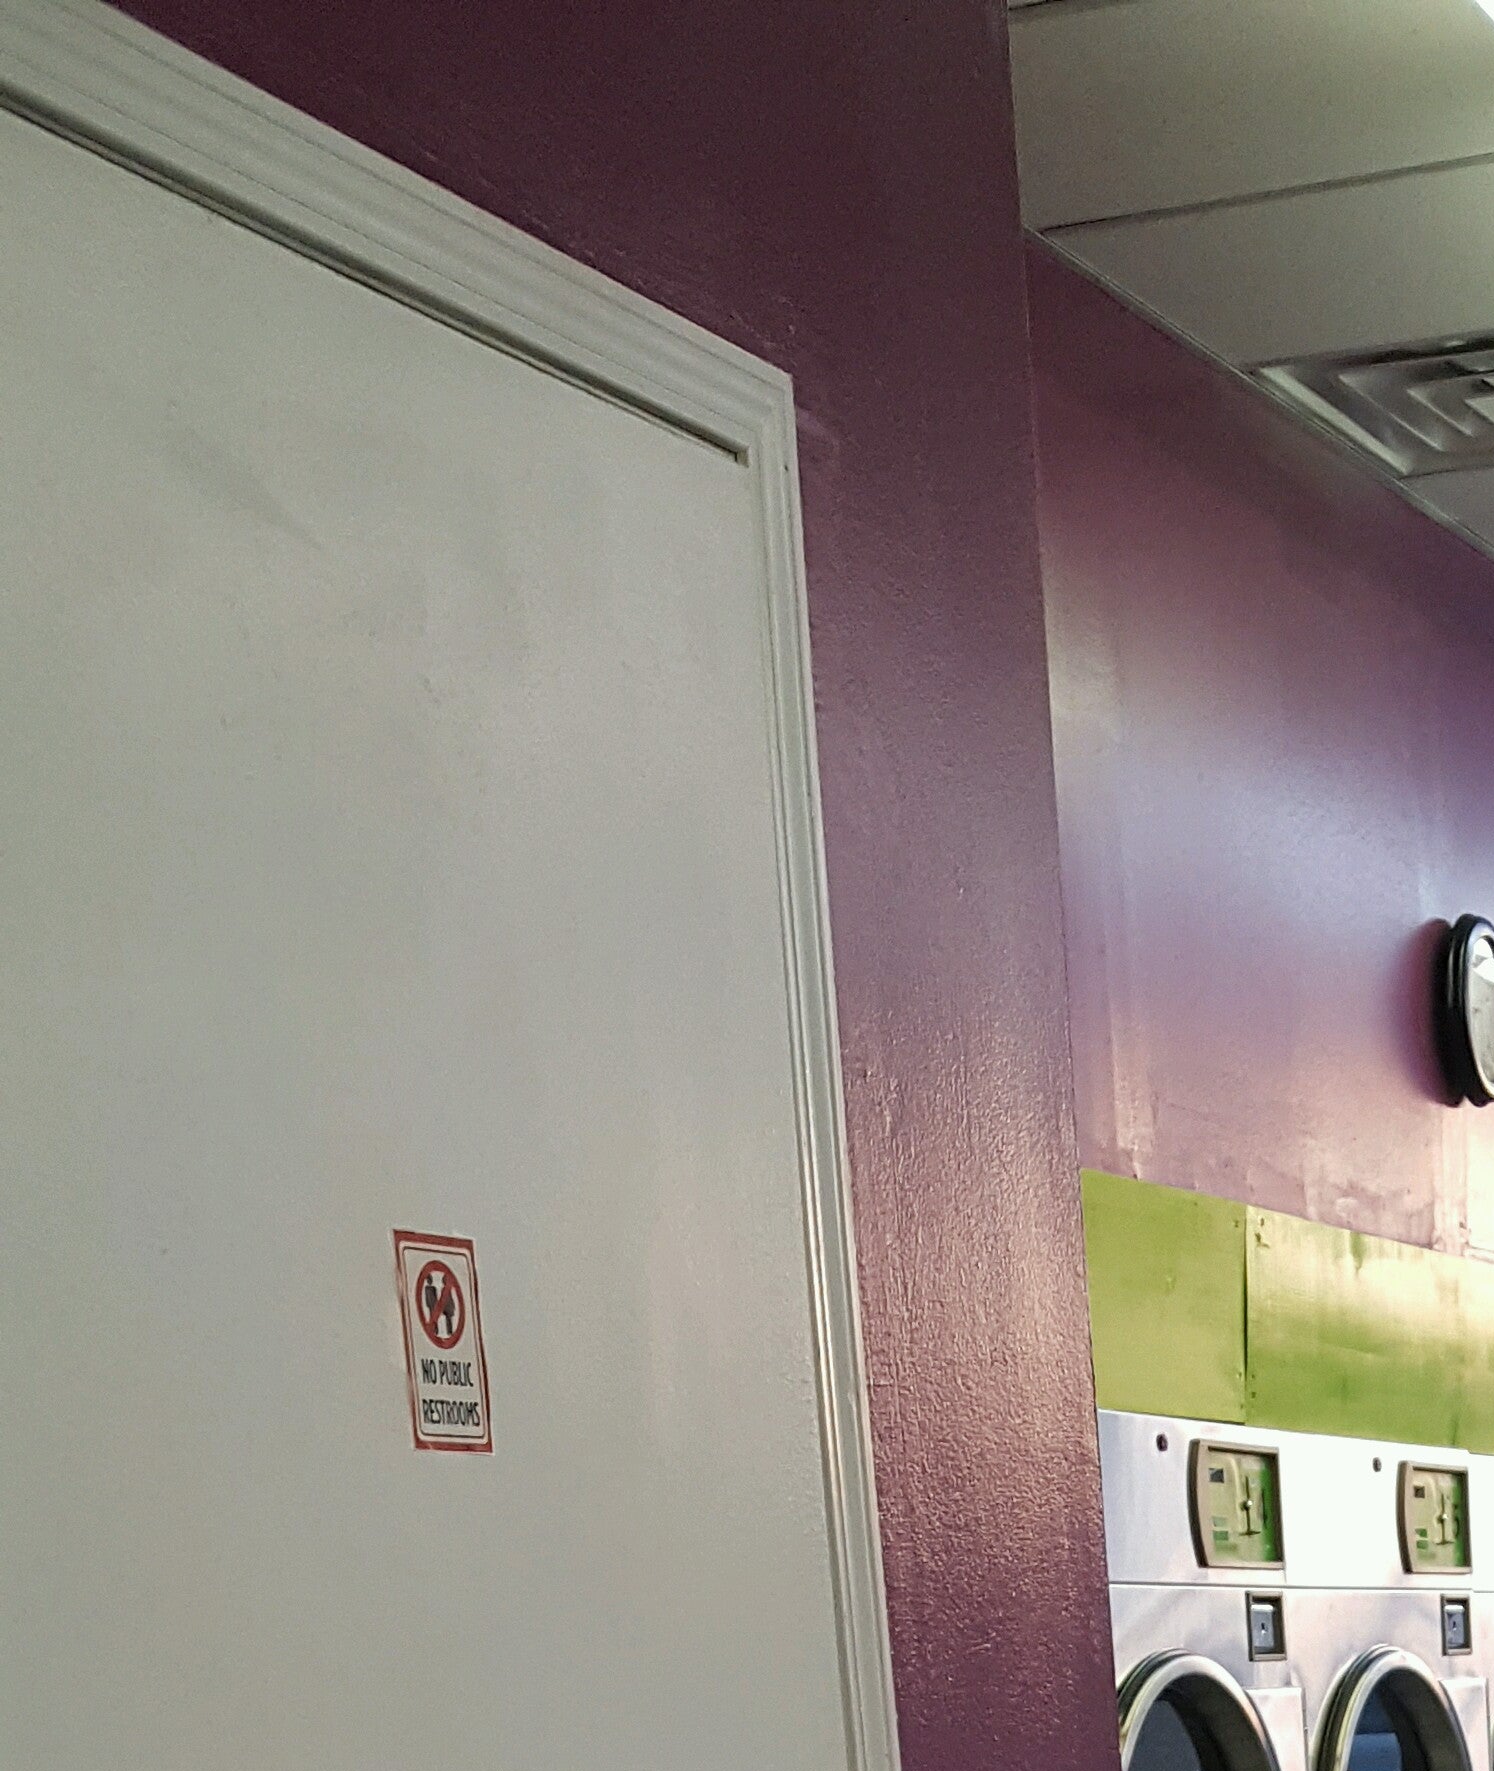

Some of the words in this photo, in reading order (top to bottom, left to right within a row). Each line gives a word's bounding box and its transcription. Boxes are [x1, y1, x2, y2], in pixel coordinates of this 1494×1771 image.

[421, 1358, 437, 1385] NO
[439, 1360, 474, 1387] PUBLIC
[422, 1399, 480, 1427] RESTROOMS
